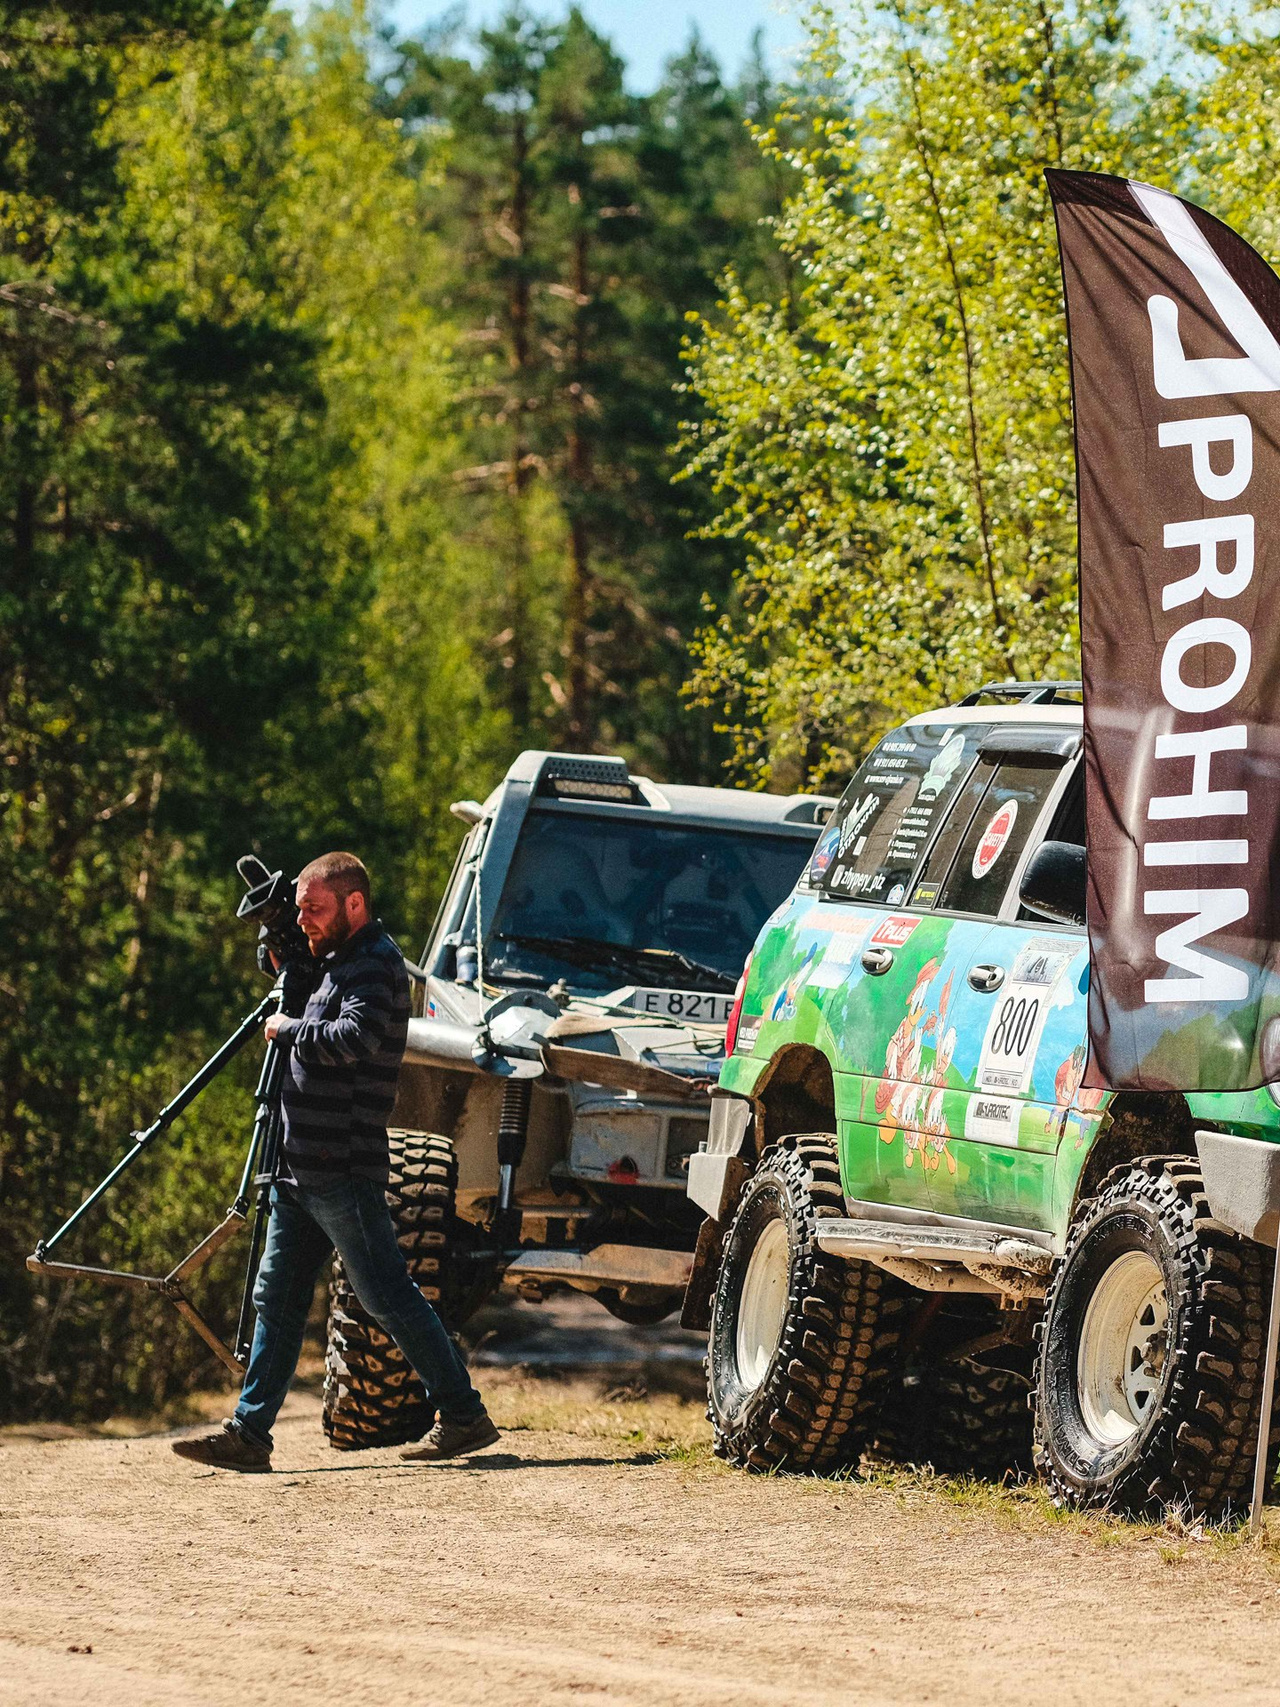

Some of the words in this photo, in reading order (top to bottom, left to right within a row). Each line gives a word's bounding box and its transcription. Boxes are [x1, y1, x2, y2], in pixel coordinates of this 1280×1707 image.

[1144, 413, 1254, 1004] PROHIM
[841, 868, 885, 892] zhypery_ptz
[991, 997, 1039, 1057] 800
